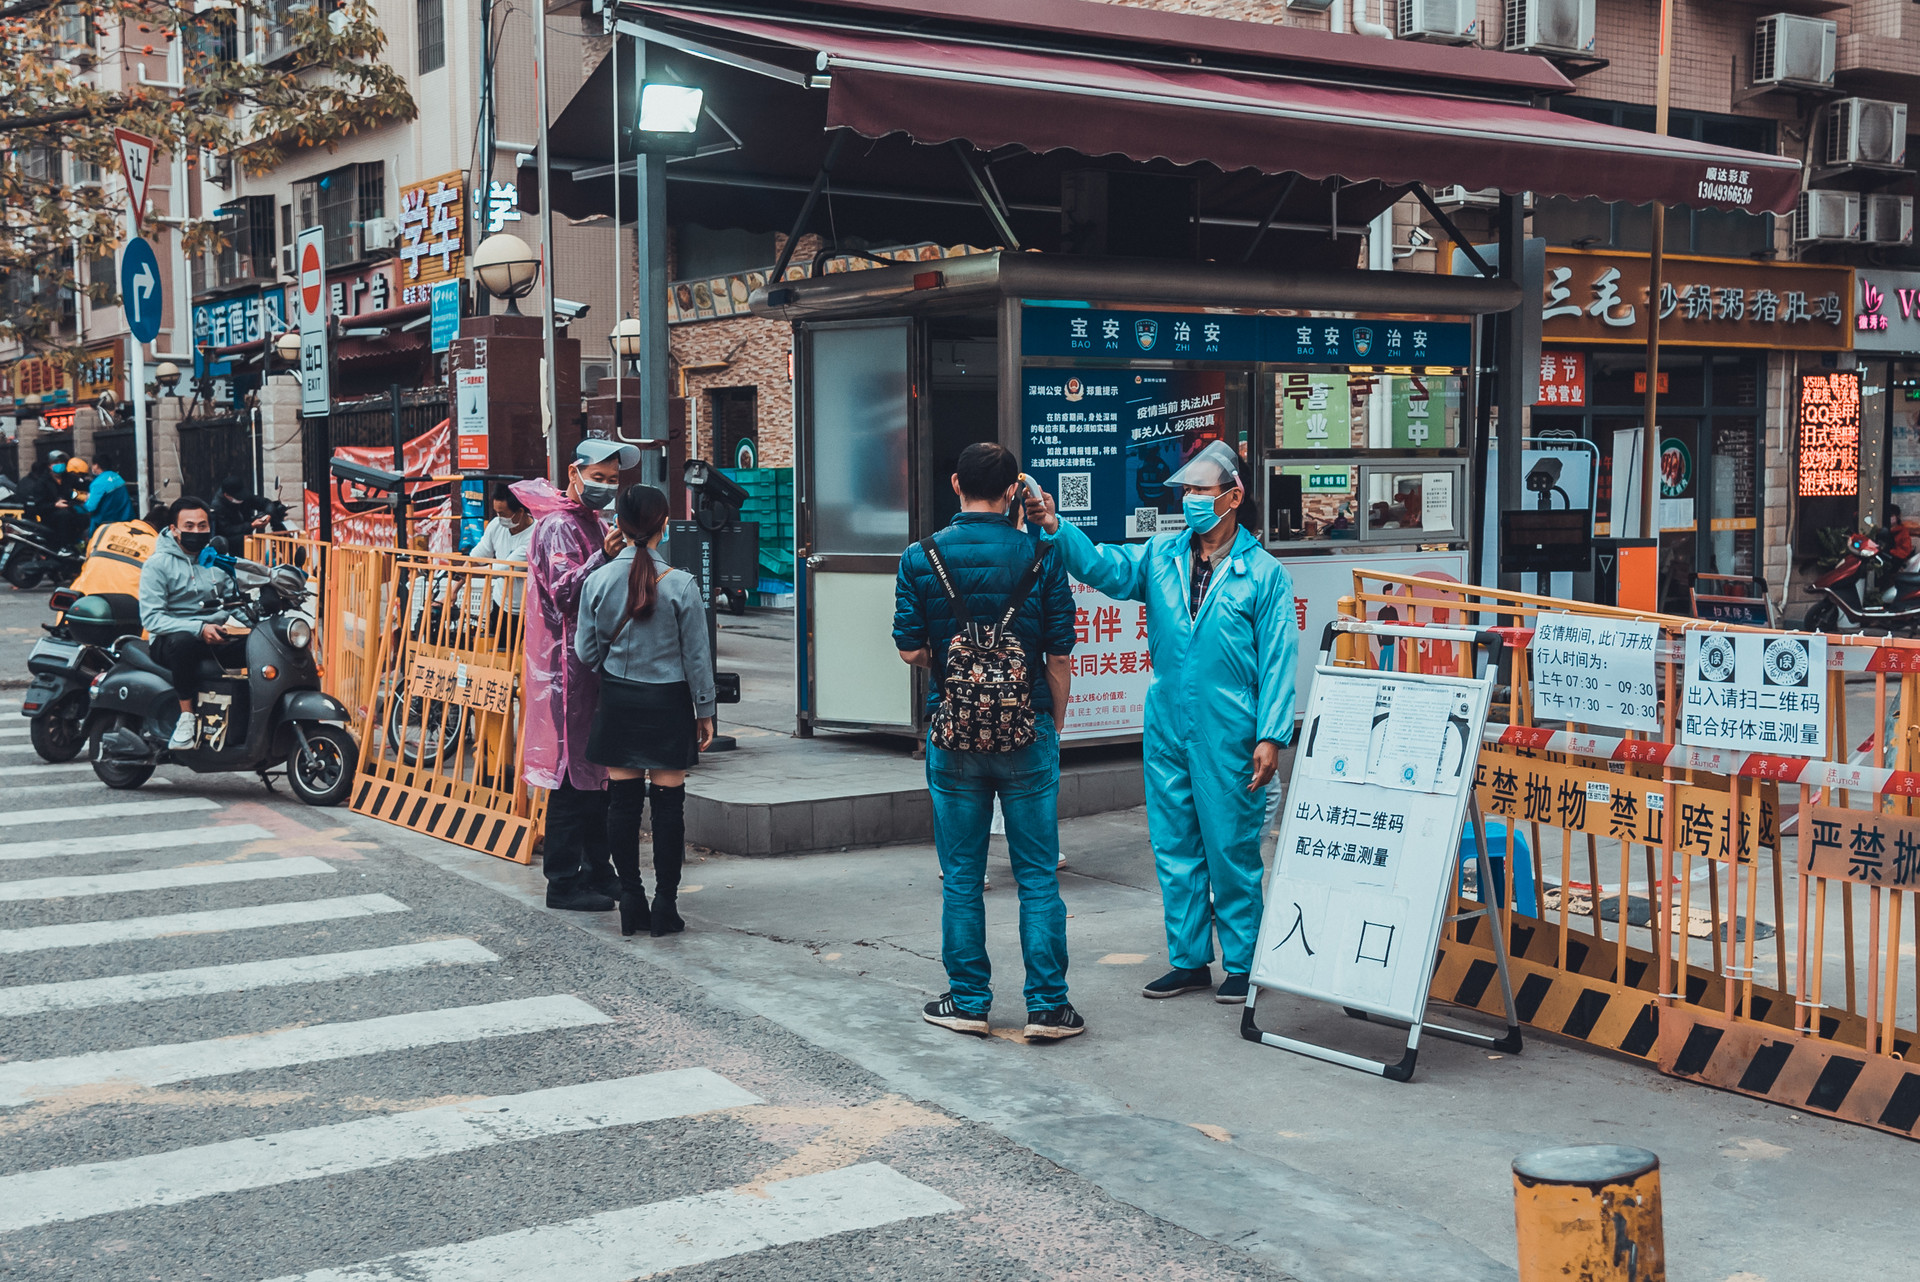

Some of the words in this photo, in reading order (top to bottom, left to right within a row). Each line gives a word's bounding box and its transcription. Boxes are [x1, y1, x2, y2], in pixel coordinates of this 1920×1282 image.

[129, 153, 144, 182] 让
[1698, 181, 1753, 205] 13049366536
[400, 181, 461, 279] 学车
[1542, 266, 1636, 327] 三毛
[1898, 288, 1920, 318] V
[1070, 318, 1120, 340] 宝安
[1174, 321, 1221, 342] 治安
[1297, 326, 1339, 347] 宝安
[1387, 329, 1428, 348] 治安
[1071, 340, 1091, 349] BAO
[1106, 341, 1118, 349] AN
[1175, 344, 1191, 352] ZHI
[1297, 347, 1315, 355] BAO
[1388, 349, 1402, 357] ZHI
[1414, 350, 1426, 358] AN
[306, 344, 322, 372] 出口
[1541, 355, 1577, 382] 春节
[307, 378, 321, 391] EXIT
[1028, 385, 1062, 396] 深圳公安
[1086, 386, 1119, 396] 郑重提示
[1137, 401, 1178, 420] 疫情当前
[1180, 393, 1221, 411] 执法从严
[1805, 402, 1855, 425] QQ美甲
[1131, 422, 1172, 440] 事关人人
[1175, 414, 1215, 432] 必须较真
[1069, 583, 1101, 594] 力争创
[1539, 624, 1653, 651] 疫情期间，此门开放
[1537, 647, 1608, 670] 行人时间为：
[1881, 661, 1917, 670] SAFE
[1888, 653, 1920, 663] 安全
[1538, 670, 1563, 687] 上午
[1565, 674, 1598, 690] 07:30
[1618, 680, 1653, 696] 09:30
[1539, 691, 1565, 708] 下午
[1568, 696, 1600, 712] 17:30
[1620, 702, 1655, 718] 20:30
[1688, 685, 1820, 714] 出入请扫二维码
[1065, 708, 1075, 718] 强
[1078, 707, 1092, 716] 民主
[1095, 706, 1109, 715] 文明
[1112, 705, 1126, 713] 和谐
[1130, 704, 1143, 713] 自由
[1515, 730, 1540, 741] 安全
[1686, 714, 1819, 745] 配合好体温测量
[1508, 737, 1535, 746] SAFE
[1567, 744, 1594, 754] CAUTION
[1569, 737, 1596, 748] 注意
[1630, 744, 1656, 756] 安全
[1623, 751, 1652, 761] SAFE
[1689, 760, 1719, 769] CAUTION
[1691, 752, 1721, 763] 注意
[1759, 760, 1789, 772] 安全
[1751, 767, 1783, 778] SAFE
[1826, 776, 1859, 787] CAUTION
[1828, 767, 1861, 780] 注意
[1476, 763, 1588, 831] 严禁抛物
[1295, 801, 1404, 834] 出入请扫二维码
[1295, 836, 1389, 868] 配合体温测量
[1272, 902, 1396, 968] 入口
